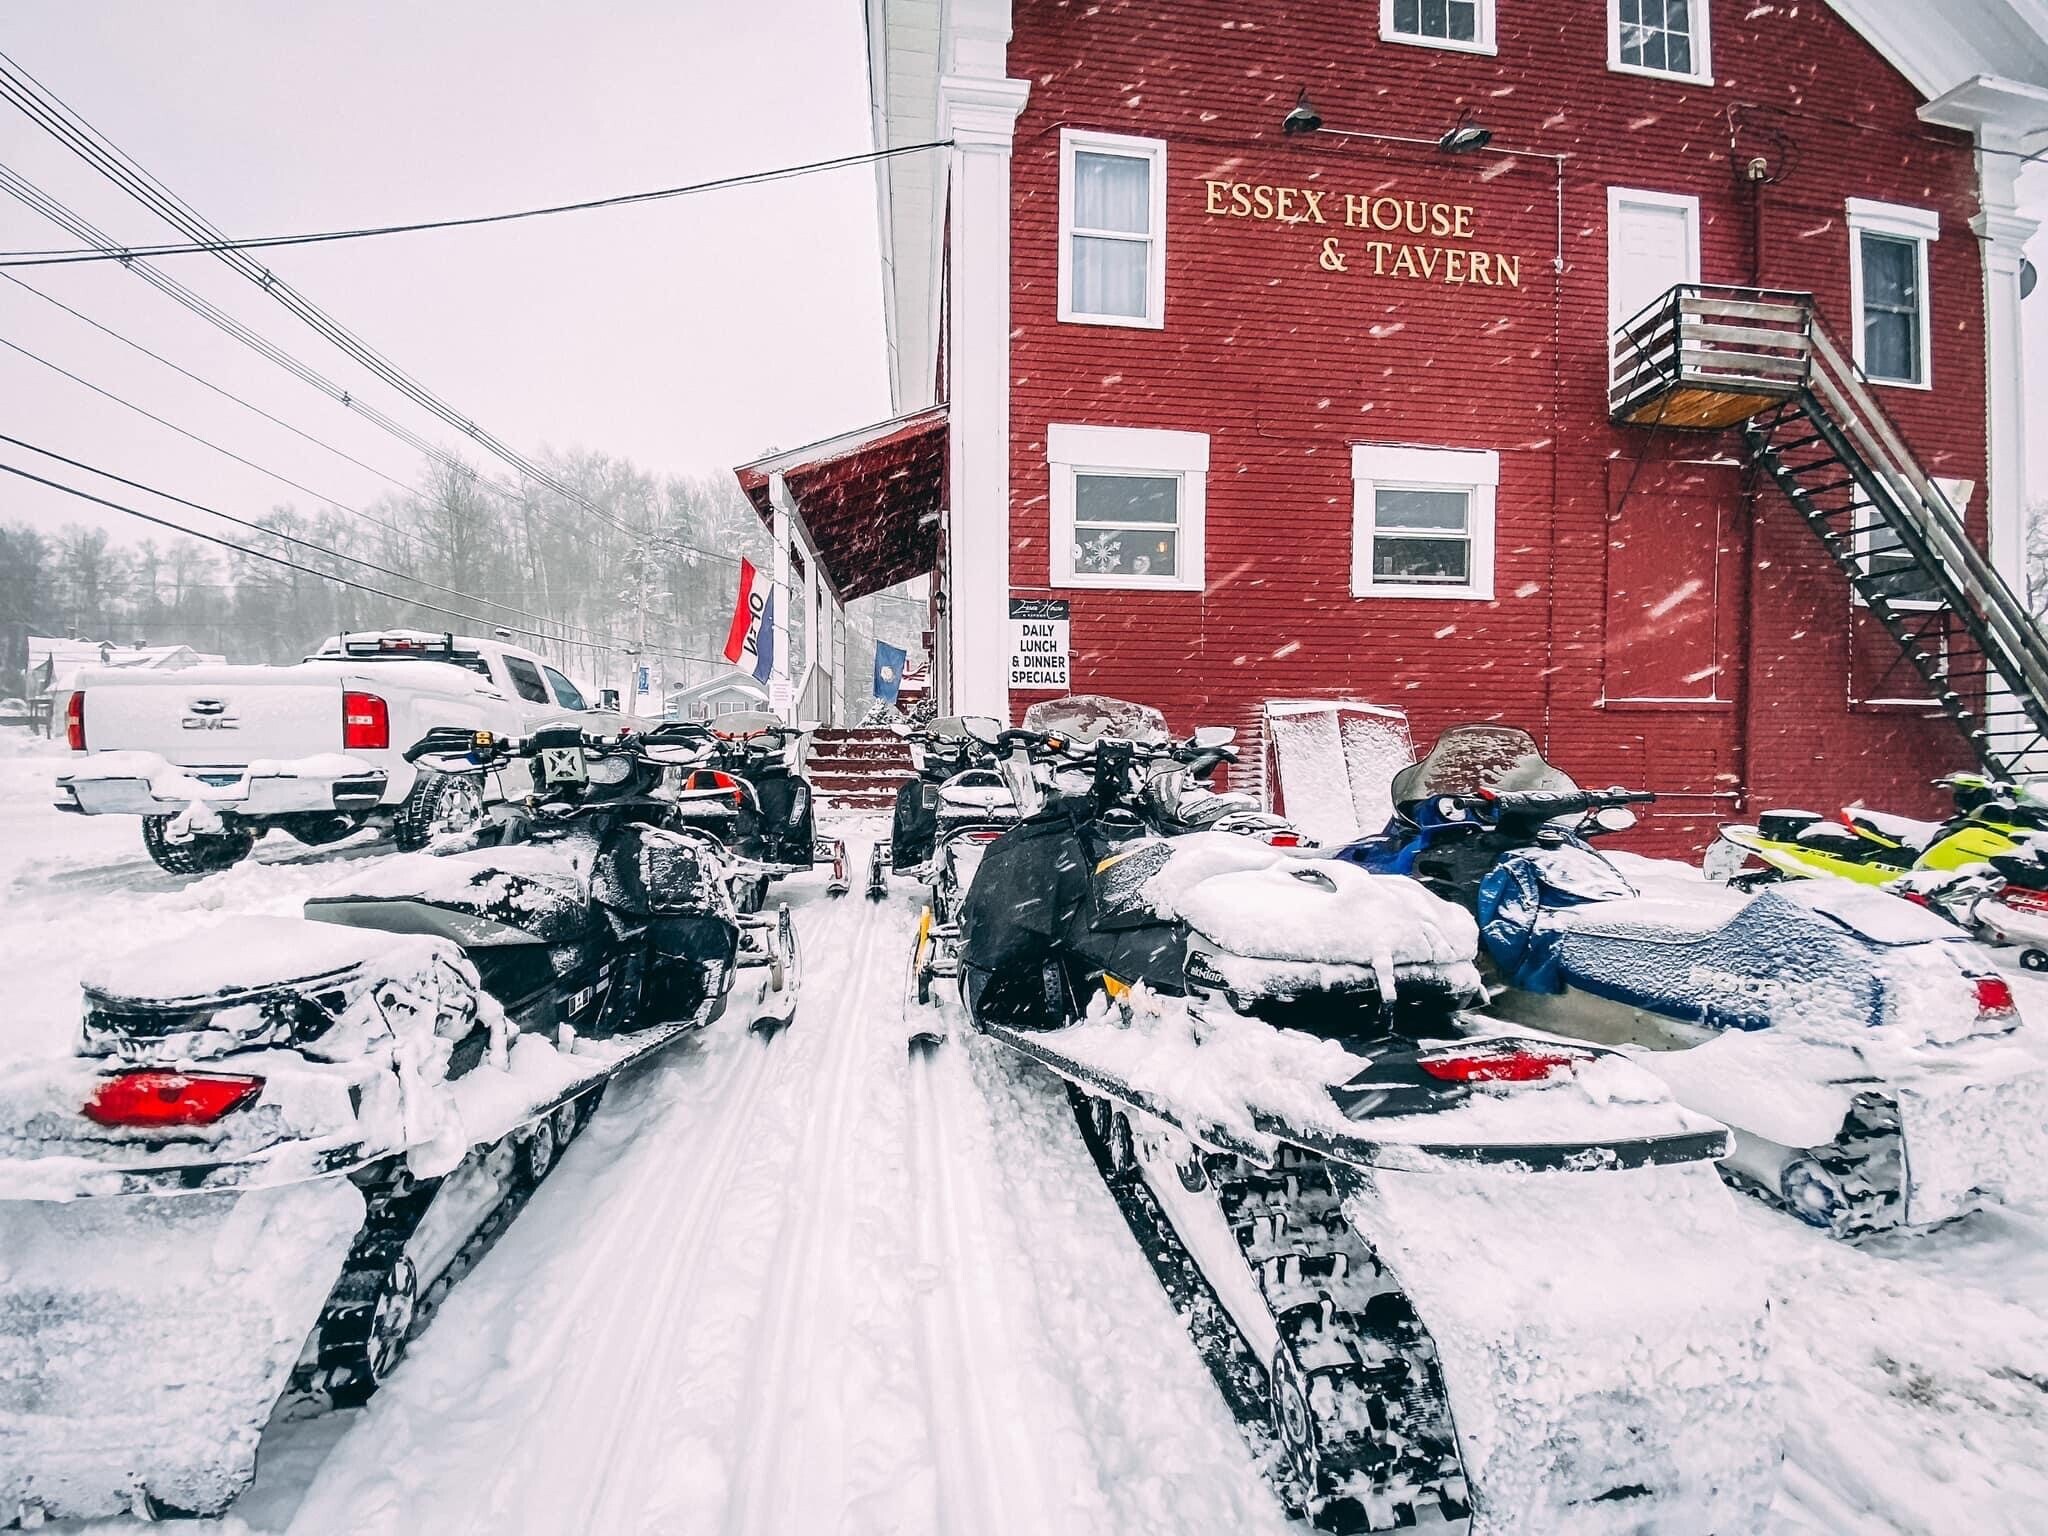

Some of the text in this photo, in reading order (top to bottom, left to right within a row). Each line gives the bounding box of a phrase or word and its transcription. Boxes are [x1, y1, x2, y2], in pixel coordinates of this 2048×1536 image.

[1204, 180, 1475, 239] ESSEX HOUSE
[1319, 237, 1520, 288] & TAVERN
[1022, 624, 1055, 637] DAILY
[1020, 639, 1057, 652] LUNCH
[1011, 655, 1065, 668] & DINNER
[1011, 671, 1066, 683] SPECIALS
